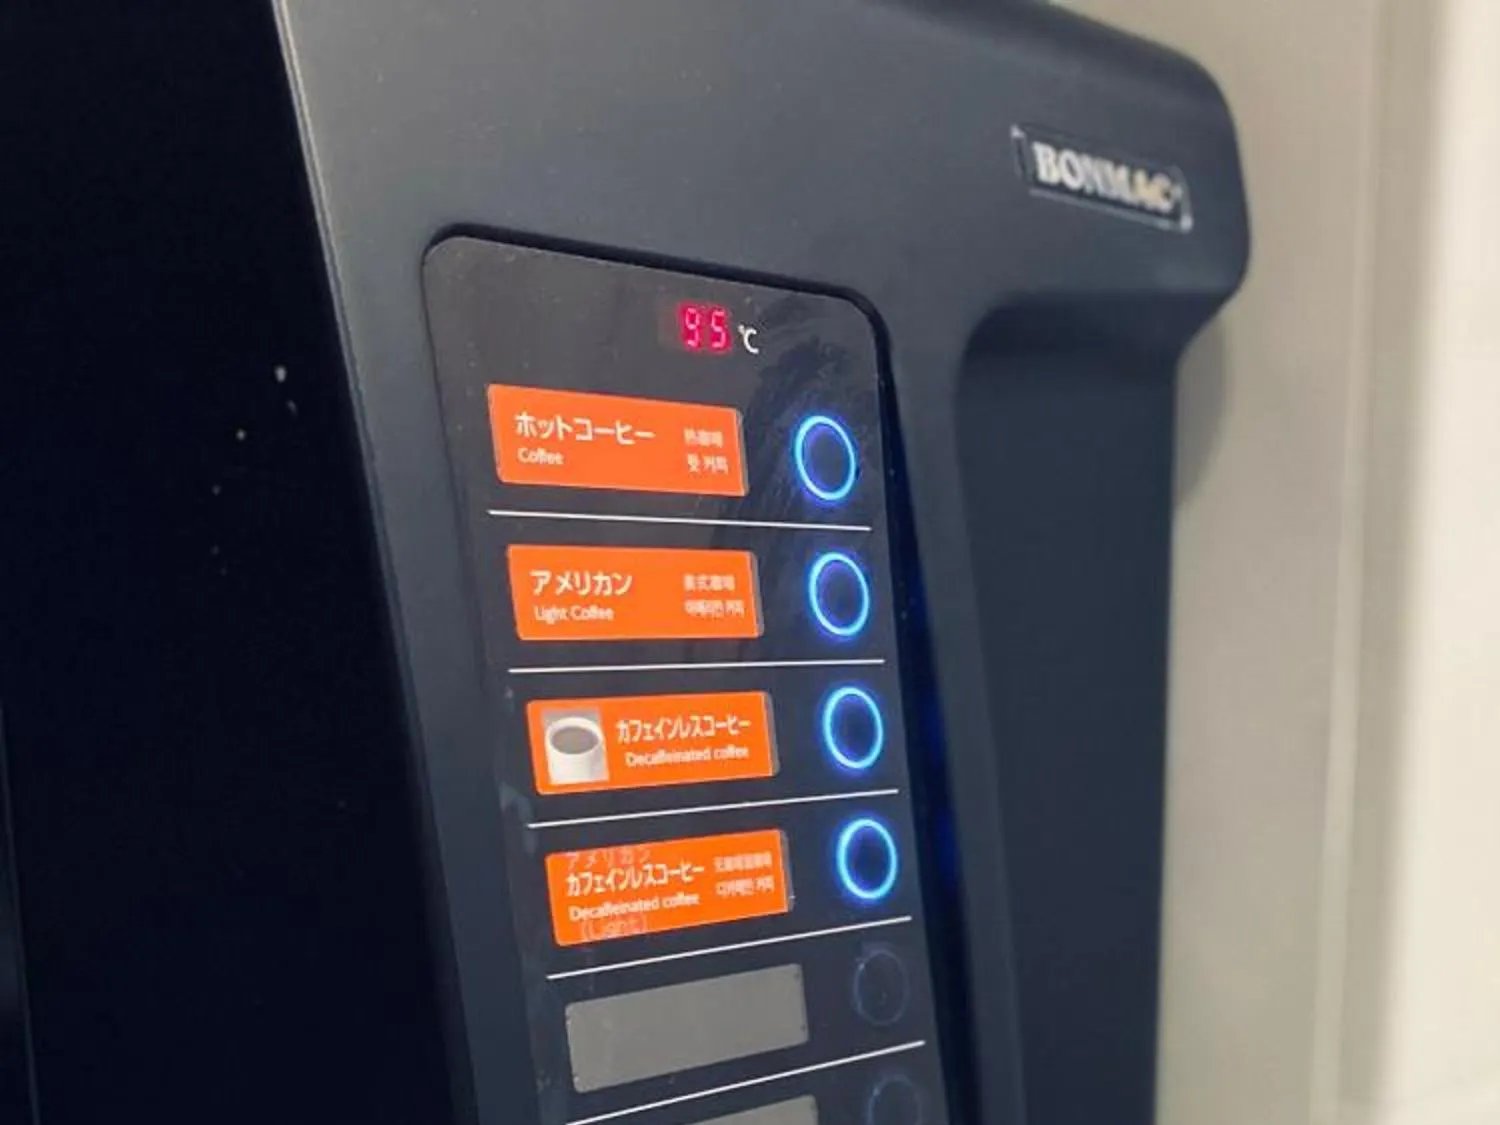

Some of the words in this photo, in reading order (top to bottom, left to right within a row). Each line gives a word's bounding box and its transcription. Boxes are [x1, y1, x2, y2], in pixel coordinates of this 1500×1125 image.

[685, 307, 727, 349] 95
[514, 411, 656, 445] ホットコーヒー
[517, 447, 564, 466] Coffee
[530, 570, 633, 597] アメリカン
[534, 604, 569, 625] Light
[571, 604, 615, 622] Coffee
[615, 715, 752, 745] カフェインレスコーヒー
[565, 861, 706, 897] カフェインレスコーヒー
